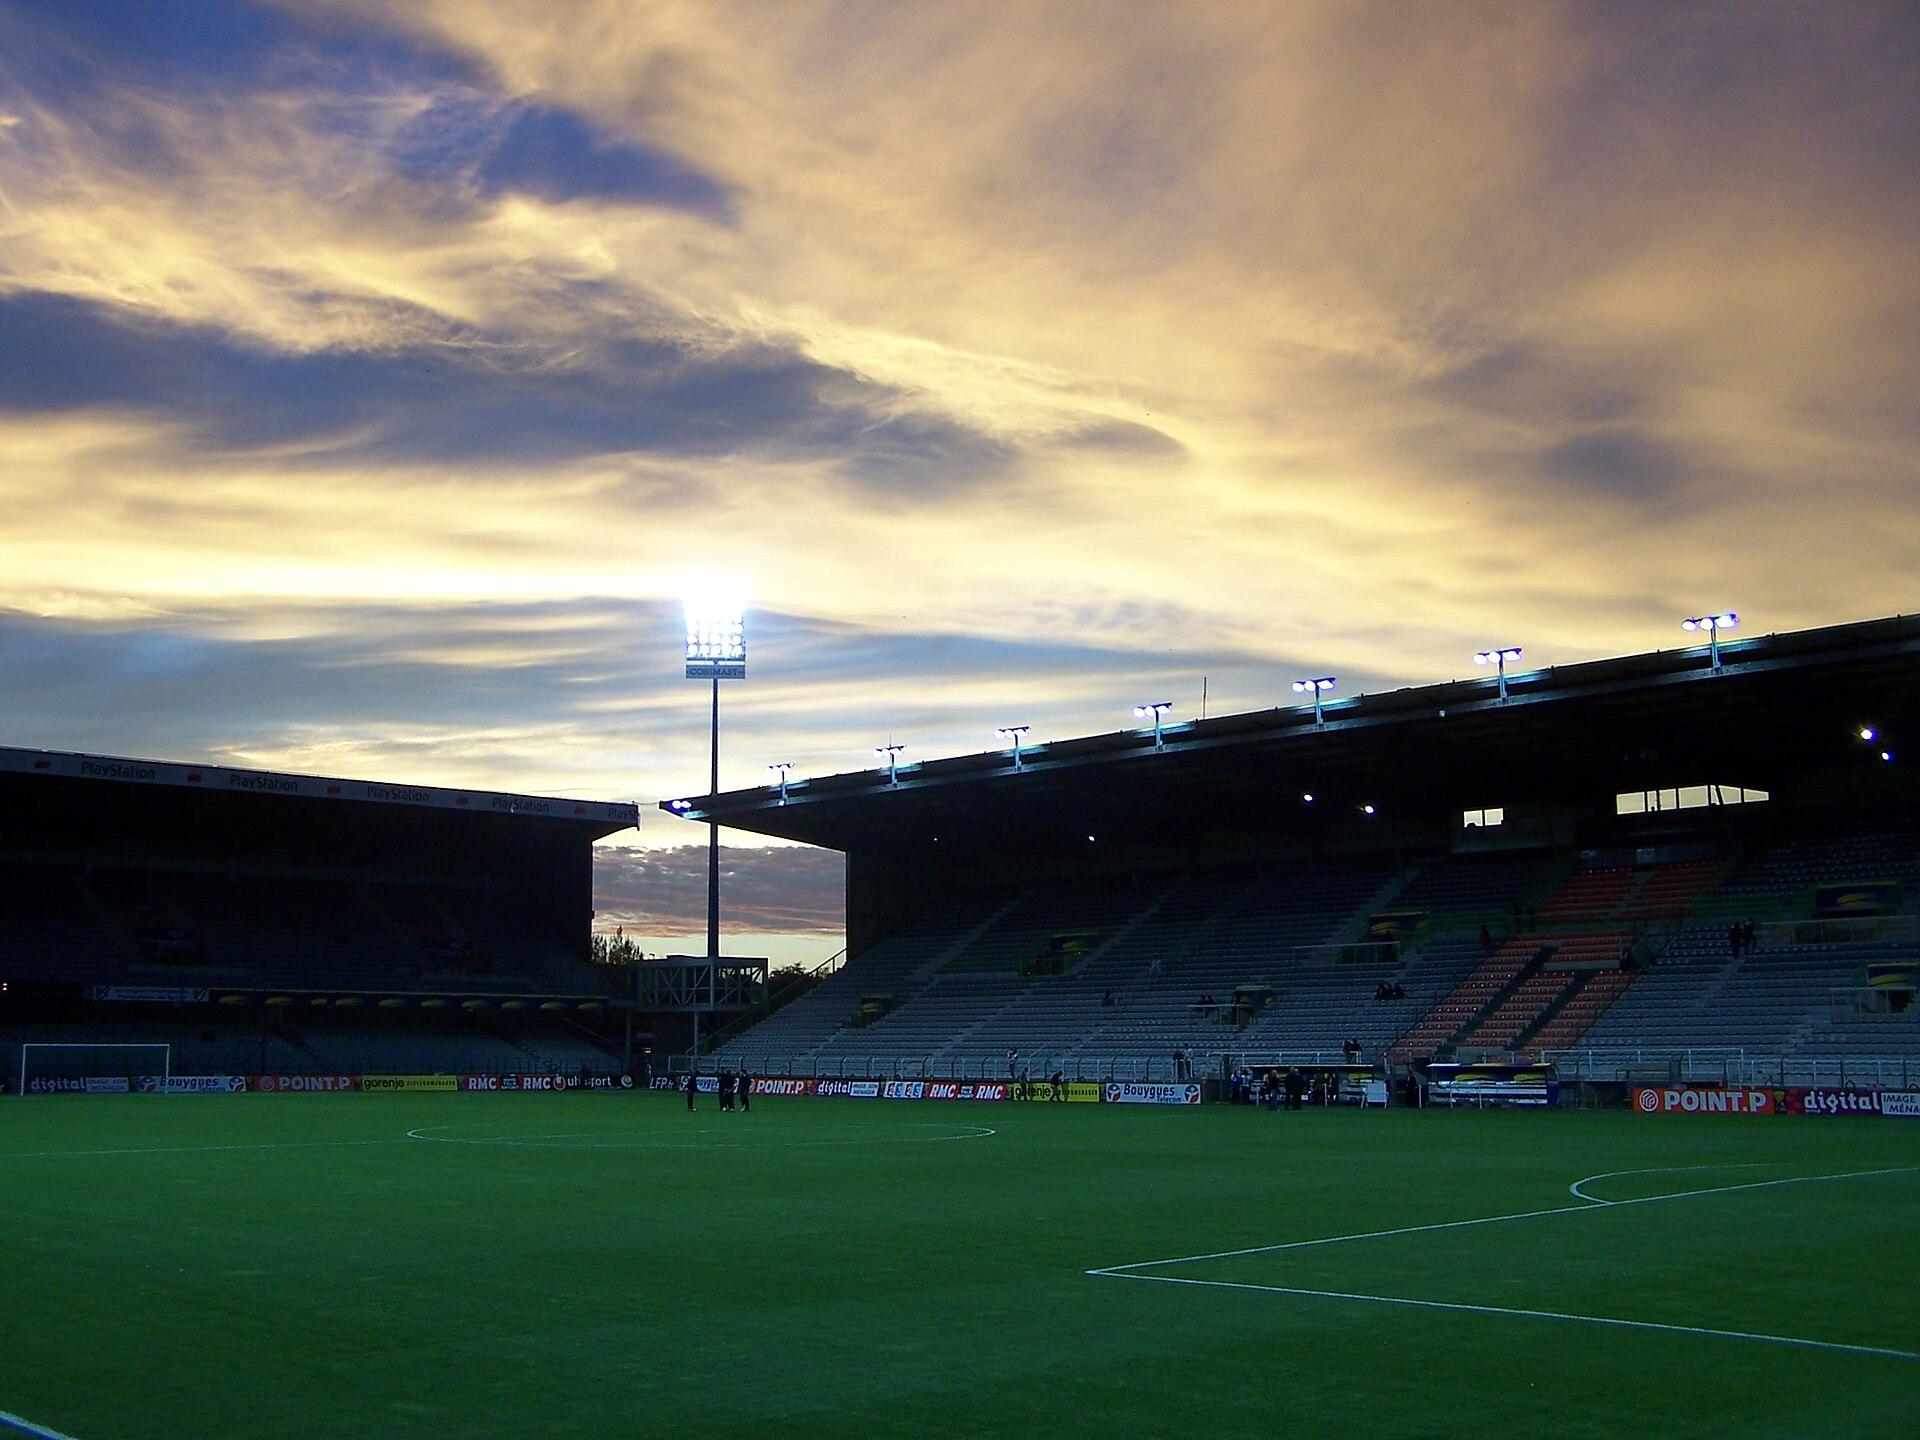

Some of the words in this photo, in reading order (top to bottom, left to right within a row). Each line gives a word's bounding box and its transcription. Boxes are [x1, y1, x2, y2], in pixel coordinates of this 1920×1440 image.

[81, 761, 155, 780] PlayStation
[230, 774, 298, 791] PlayStation
[367, 786, 430, 803] PlayStation
[492, 797, 550, 813] PlayStation
[31, 1077, 86, 1092] digital
[159, 1077, 218, 1089] Bouygues
[279, 1076, 351, 1091] POINT.P
[363, 1077, 405, 1090] gorenje
[468, 1076, 497, 1090] RMC
[522, 1076, 551, 1090] RMC
[756, 1079, 805, 1094] POINT.P
[817, 1080, 852, 1096] digital
[929, 1083, 957, 1098] RMC
[976, 1084, 1004, 1099] RMC
[1123, 1084, 1175, 1099] Bouygues
[1883, 1094, 1915, 1103] IMAGE
[1664, 1090, 1767, 1112] POINT.P
[1803, 1090, 1880, 1114] digital
